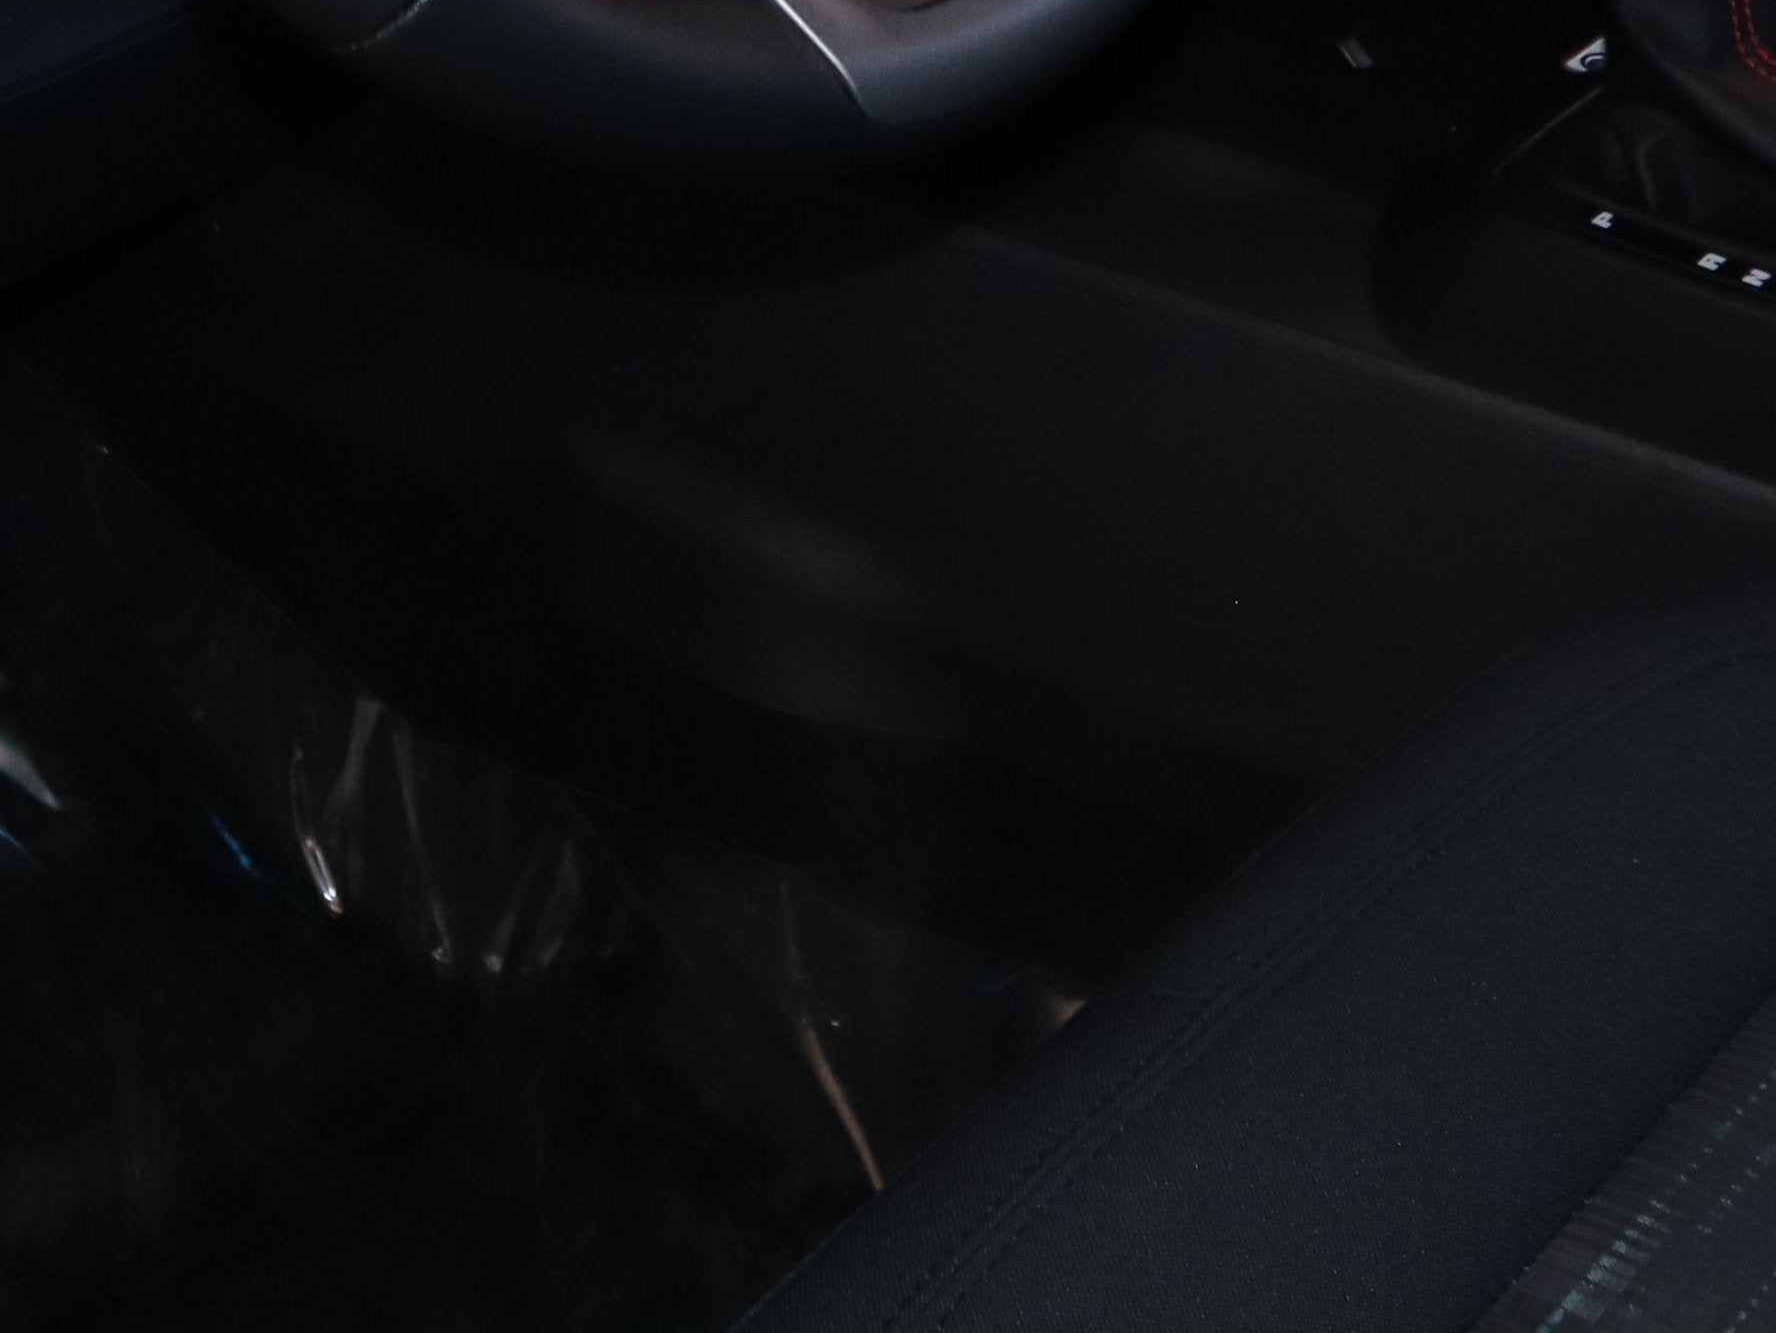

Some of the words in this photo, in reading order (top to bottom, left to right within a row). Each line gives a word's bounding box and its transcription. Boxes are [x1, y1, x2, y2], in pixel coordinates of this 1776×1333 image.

[1590, 210, 1616, 230] P
[1696, 252, 1728, 272] R
[1741, 267, 1773, 288] N
